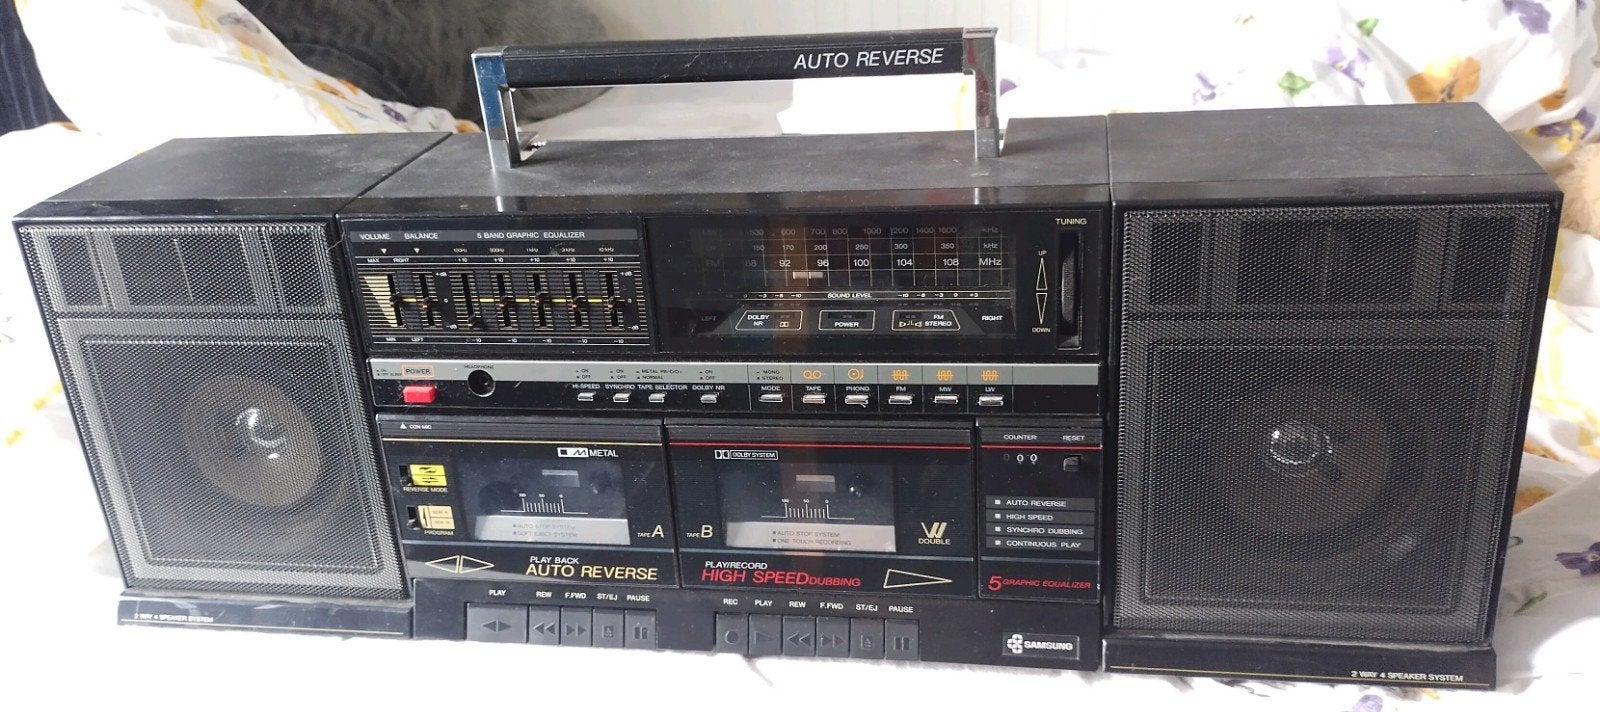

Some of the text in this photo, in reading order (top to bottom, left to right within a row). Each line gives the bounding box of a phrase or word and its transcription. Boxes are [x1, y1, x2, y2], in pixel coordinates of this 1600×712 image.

[793, 48, 944, 70] AUTO REVERSE
[863, 227, 881, 235] 1000
[940, 242, 955, 250] 350
[779, 259, 791, 267] 92
[817, 259, 829, 267] 96
[853, 258, 870, 267] 100
[896, 258, 913, 266] 104
[943, 258, 959, 266] 108
[978, 257, 1002, 266] MHz
[589, 449, 619, 457] METAL
[651, 524, 665, 538] A
[700, 524, 713, 538] B
[1006, 526, 1083, 535] SYNCHRO DUBBING
[1006, 540, 1057, 548] CONTINUOUS
[529, 556, 580, 564] PLAY BACK
[705, 560, 768, 570] PLAY/RECORD
[525, 563, 658, 581] AUTO REVERSE
[701, 569, 862, 587] HIGH SPEED DUBBING
[987, 575, 1092, 591] 5 GRAPHIC EQUALIZER
[596, 593, 618, 601] ST/EJ
[626, 594, 650, 602] PAUSE
[723, 598, 738, 606] REC
[754, 599, 773, 607] PLAY
[788, 600, 806, 608] REW
[819, 602, 844, 610] F.FWD
[855, 603, 878, 612] ST/EJ
[888, 604, 914, 613] PAUSE
[1023, 640, 1073, 651] SAMSUNG
[1351, 670, 1359, 678] 2
[1379, 671, 1386, 679] 4
[1387, 671, 1427, 680] SPEAKER
[1428, 673, 1464, 682] SYSTEM
